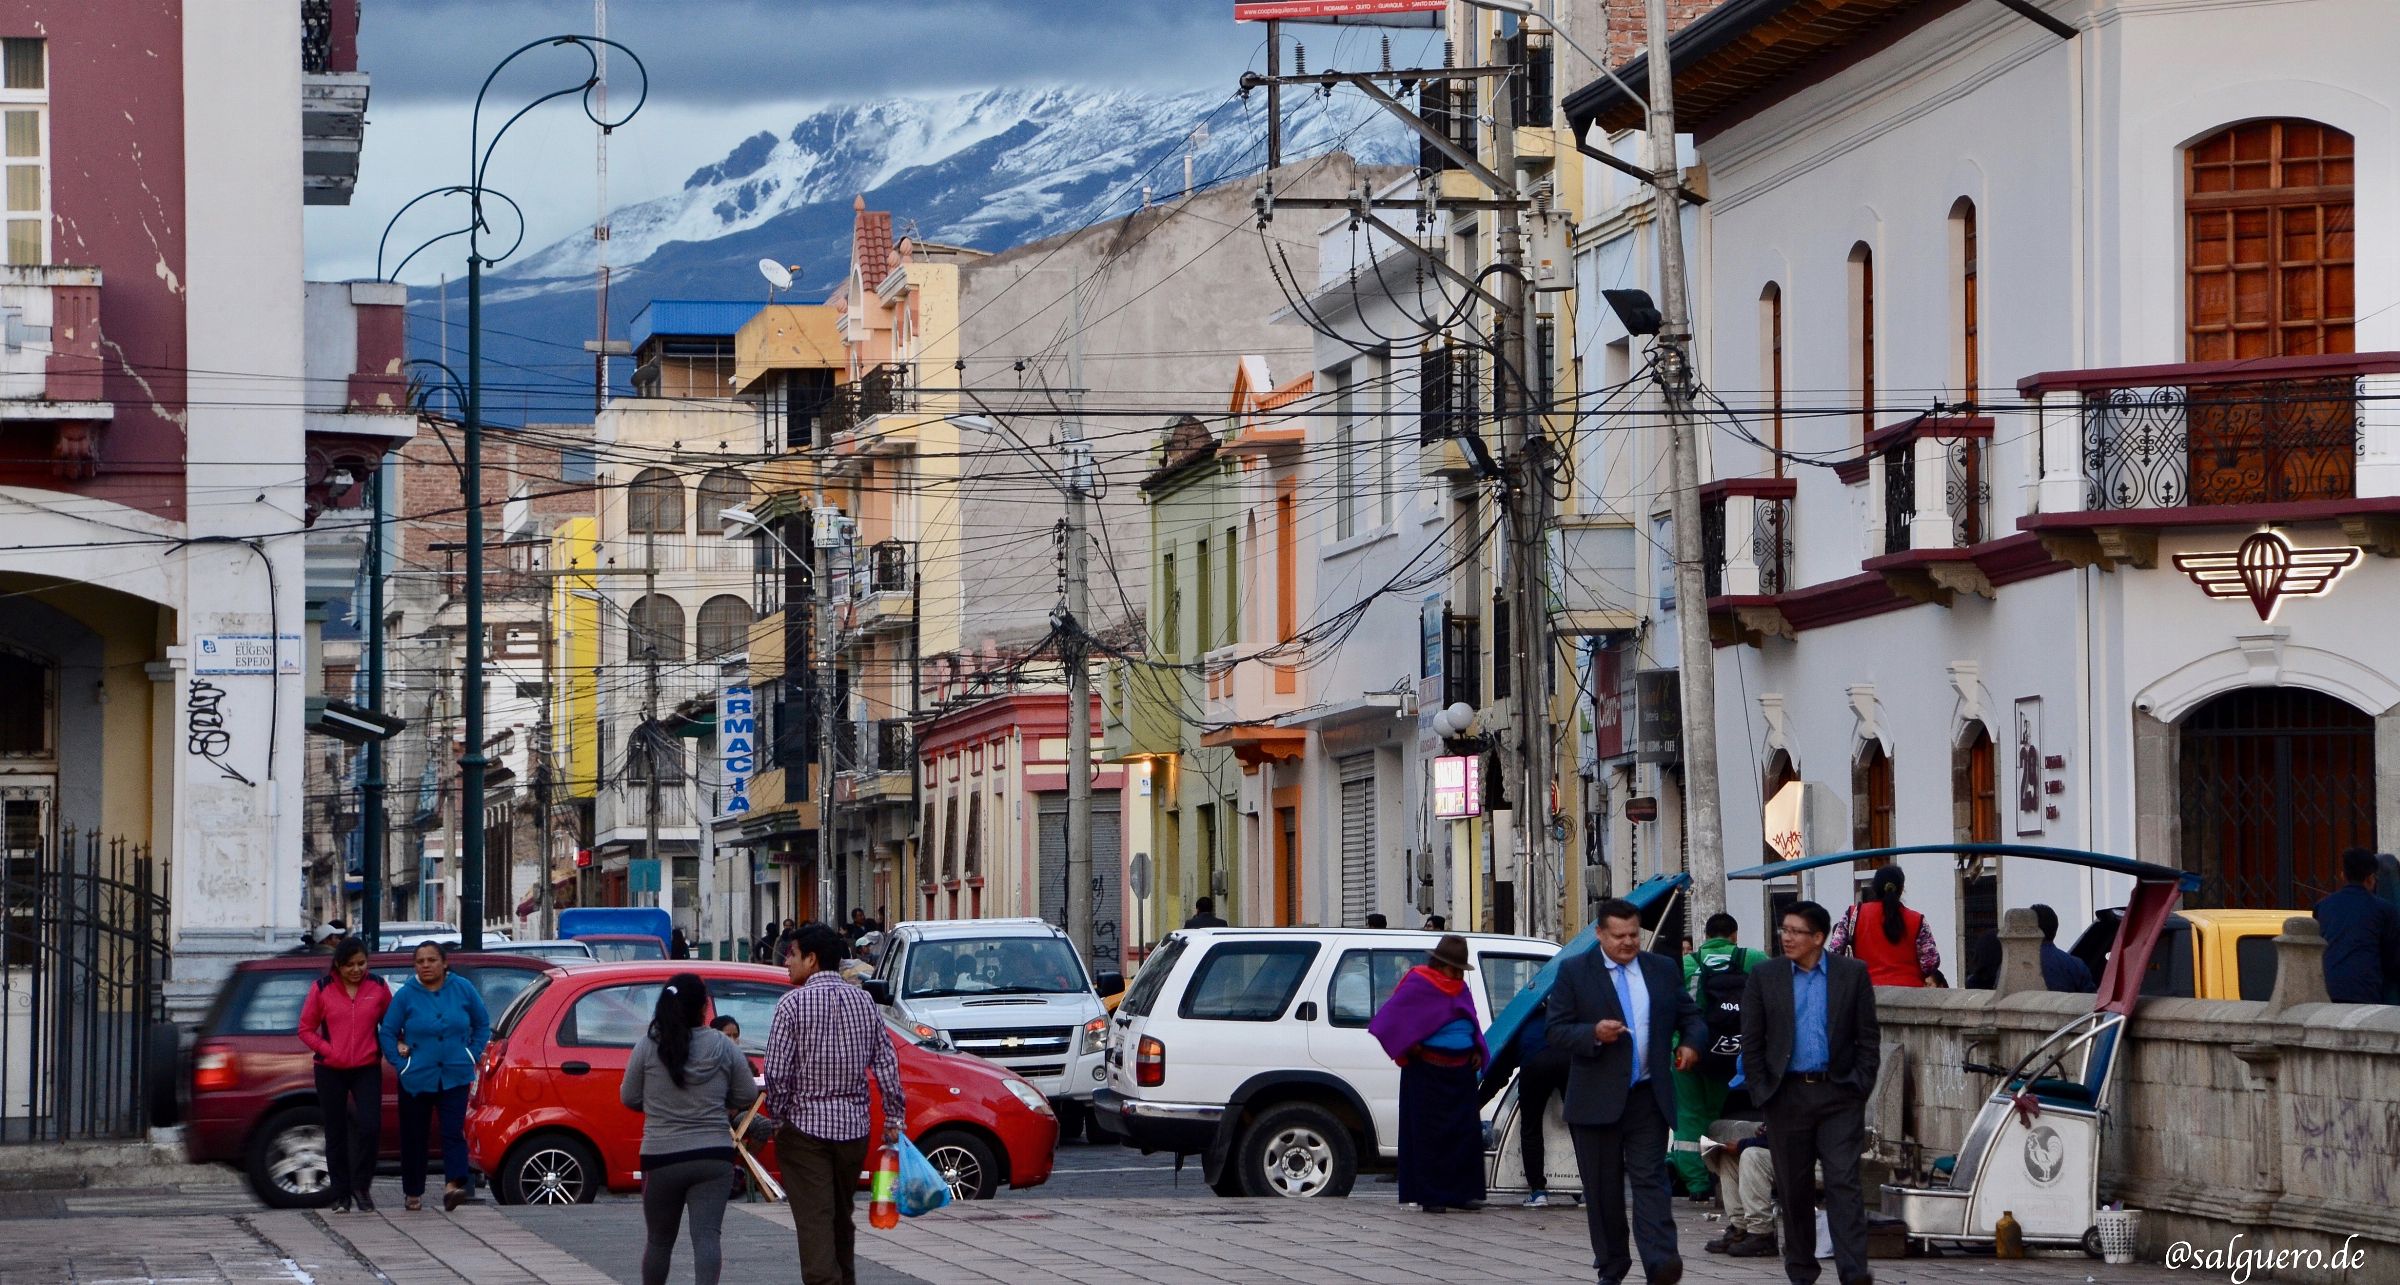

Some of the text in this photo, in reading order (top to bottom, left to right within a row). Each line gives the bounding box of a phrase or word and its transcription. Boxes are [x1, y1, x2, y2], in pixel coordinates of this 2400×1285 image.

[236, 646, 273, 656] EUGENI
[236, 657, 270, 667] ESPEJO
[1599, 692, 1618, 730] Claro
[1470, 759, 1479, 811] BAZAR
[1720, 1002, 1740, 1012] 404
